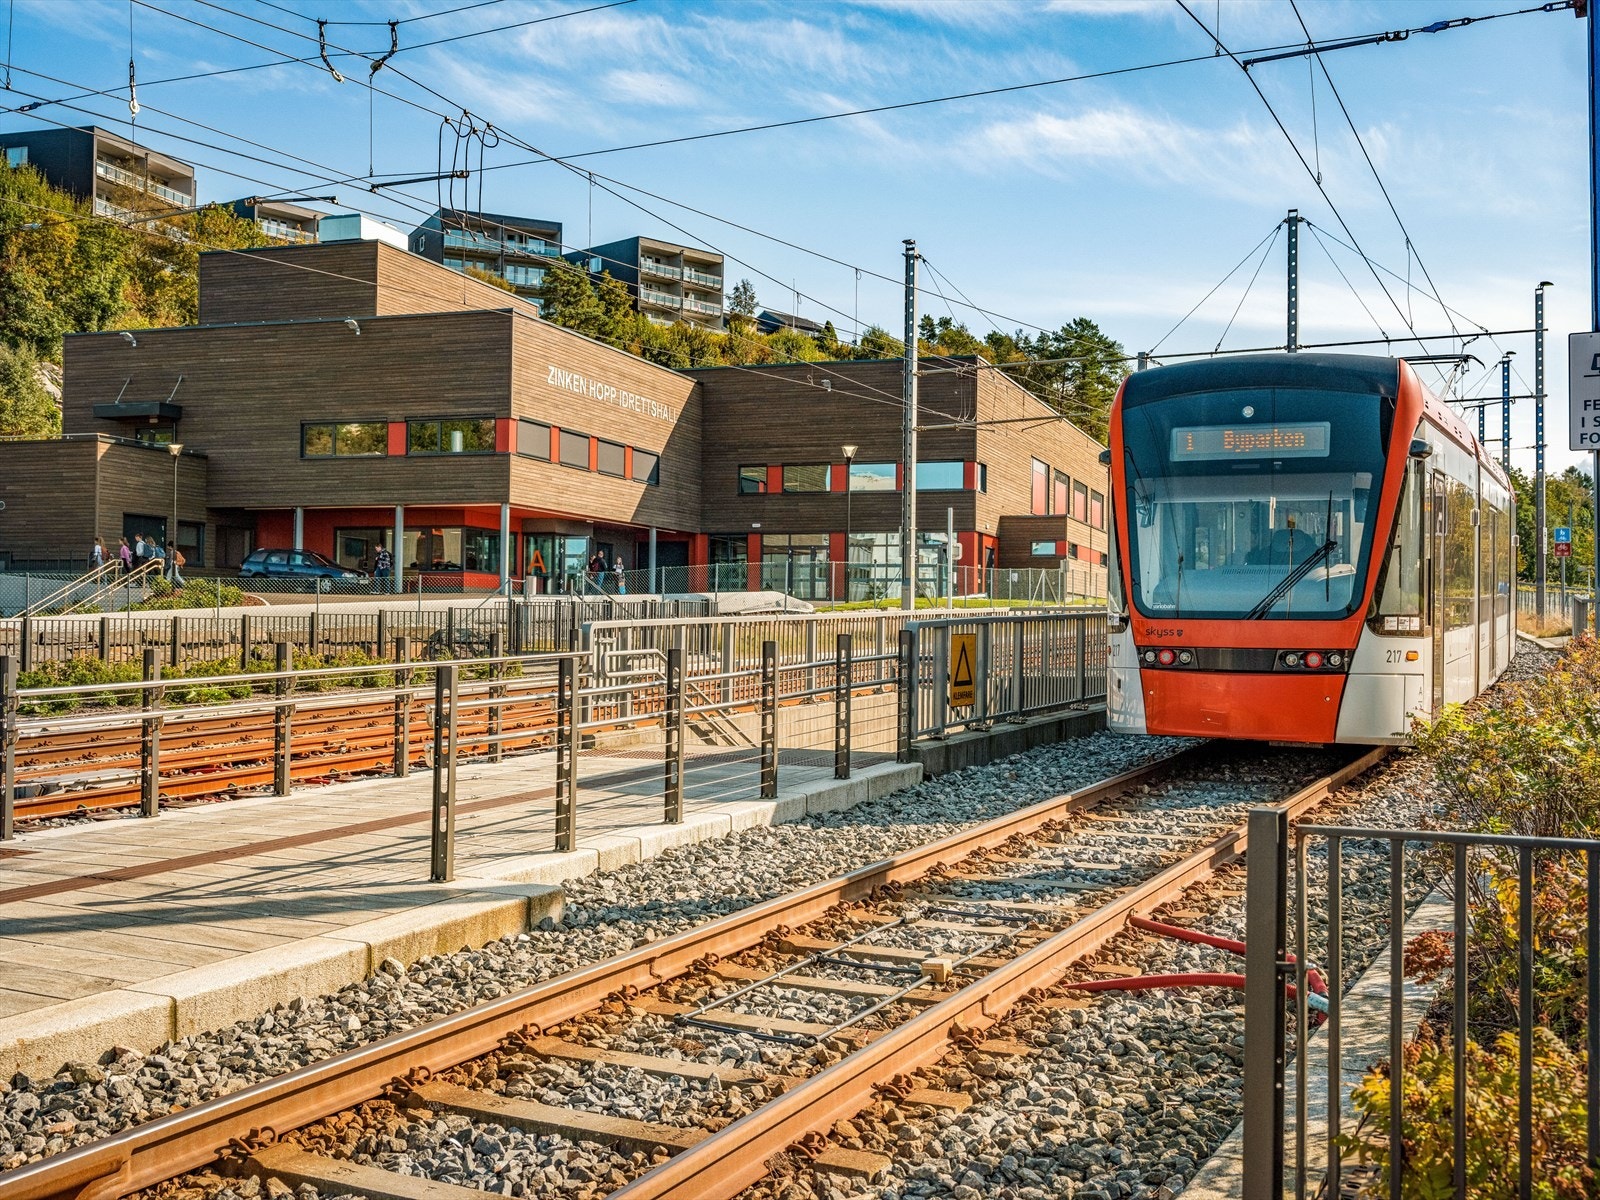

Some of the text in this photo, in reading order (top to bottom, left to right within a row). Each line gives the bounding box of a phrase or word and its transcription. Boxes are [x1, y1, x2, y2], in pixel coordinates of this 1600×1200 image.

[547, 365, 678, 424] ZINKEN HOPP IDRETTSHALL
[1186, 429, 1305, 453] 1 Byparken
[527, 550, 547, 574] A
[1145, 625, 1175, 638] skyss
[1386, 649, 1402, 664] 217
